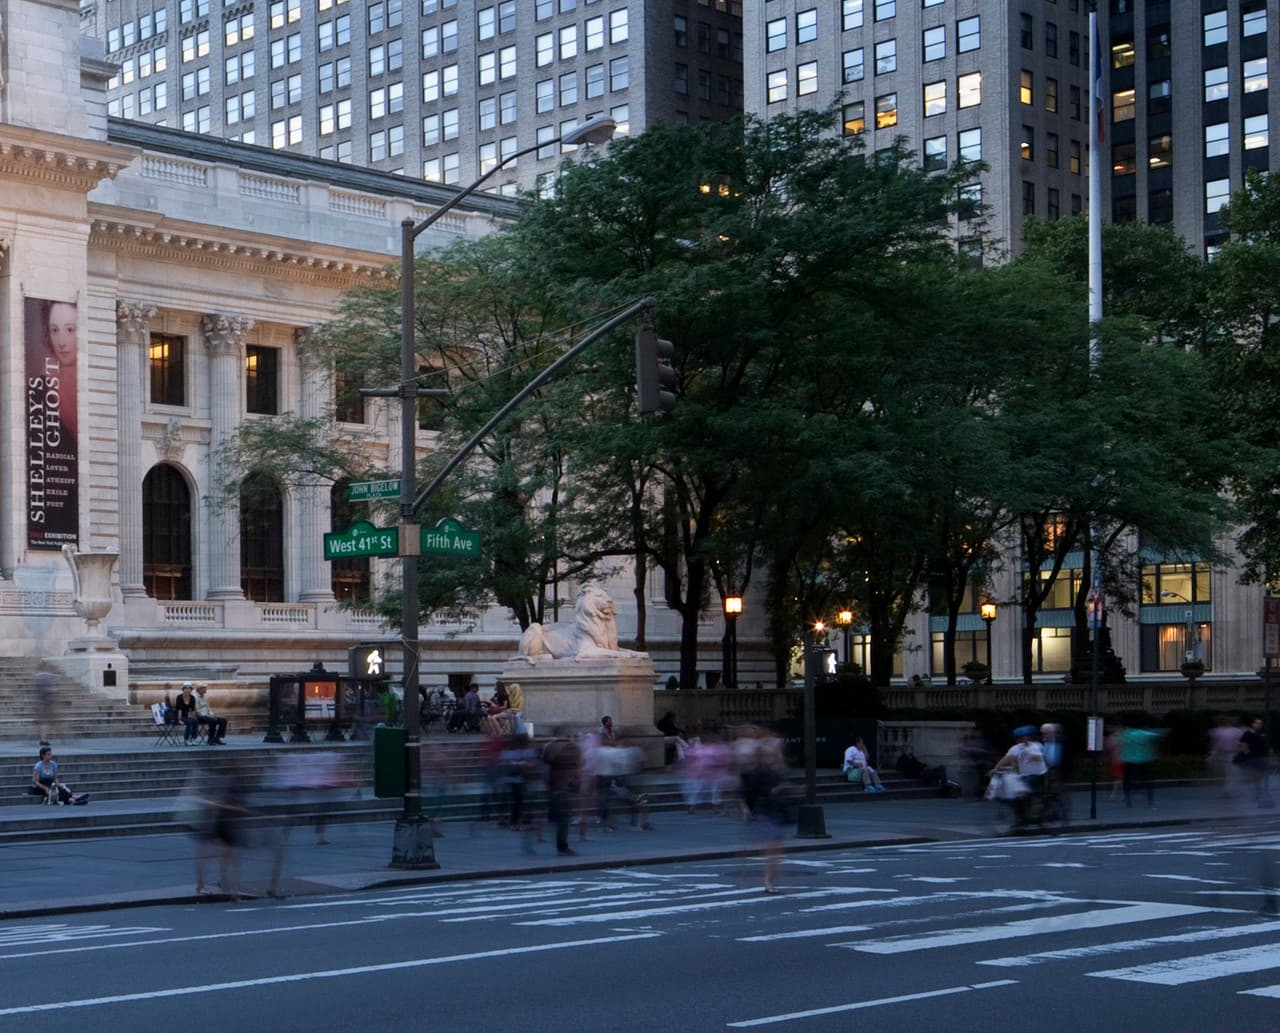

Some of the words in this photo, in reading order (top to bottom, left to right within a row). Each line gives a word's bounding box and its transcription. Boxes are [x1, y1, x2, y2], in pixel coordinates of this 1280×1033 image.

[45, 357, 61, 447] GHOST
[29, 377, 45, 523] SHELLEY'S
[351, 483, 368, 495] JOHN
[371, 481, 399, 493] BIGELOW
[44, 532, 77, 540] EXHIBITION
[330, 539, 357, 553] West
[358, 535, 378, 551] 41st
[380, 535, 393, 550] St
[426, 533, 451, 549] Fifth
[453, 536, 473, 550] Ave
